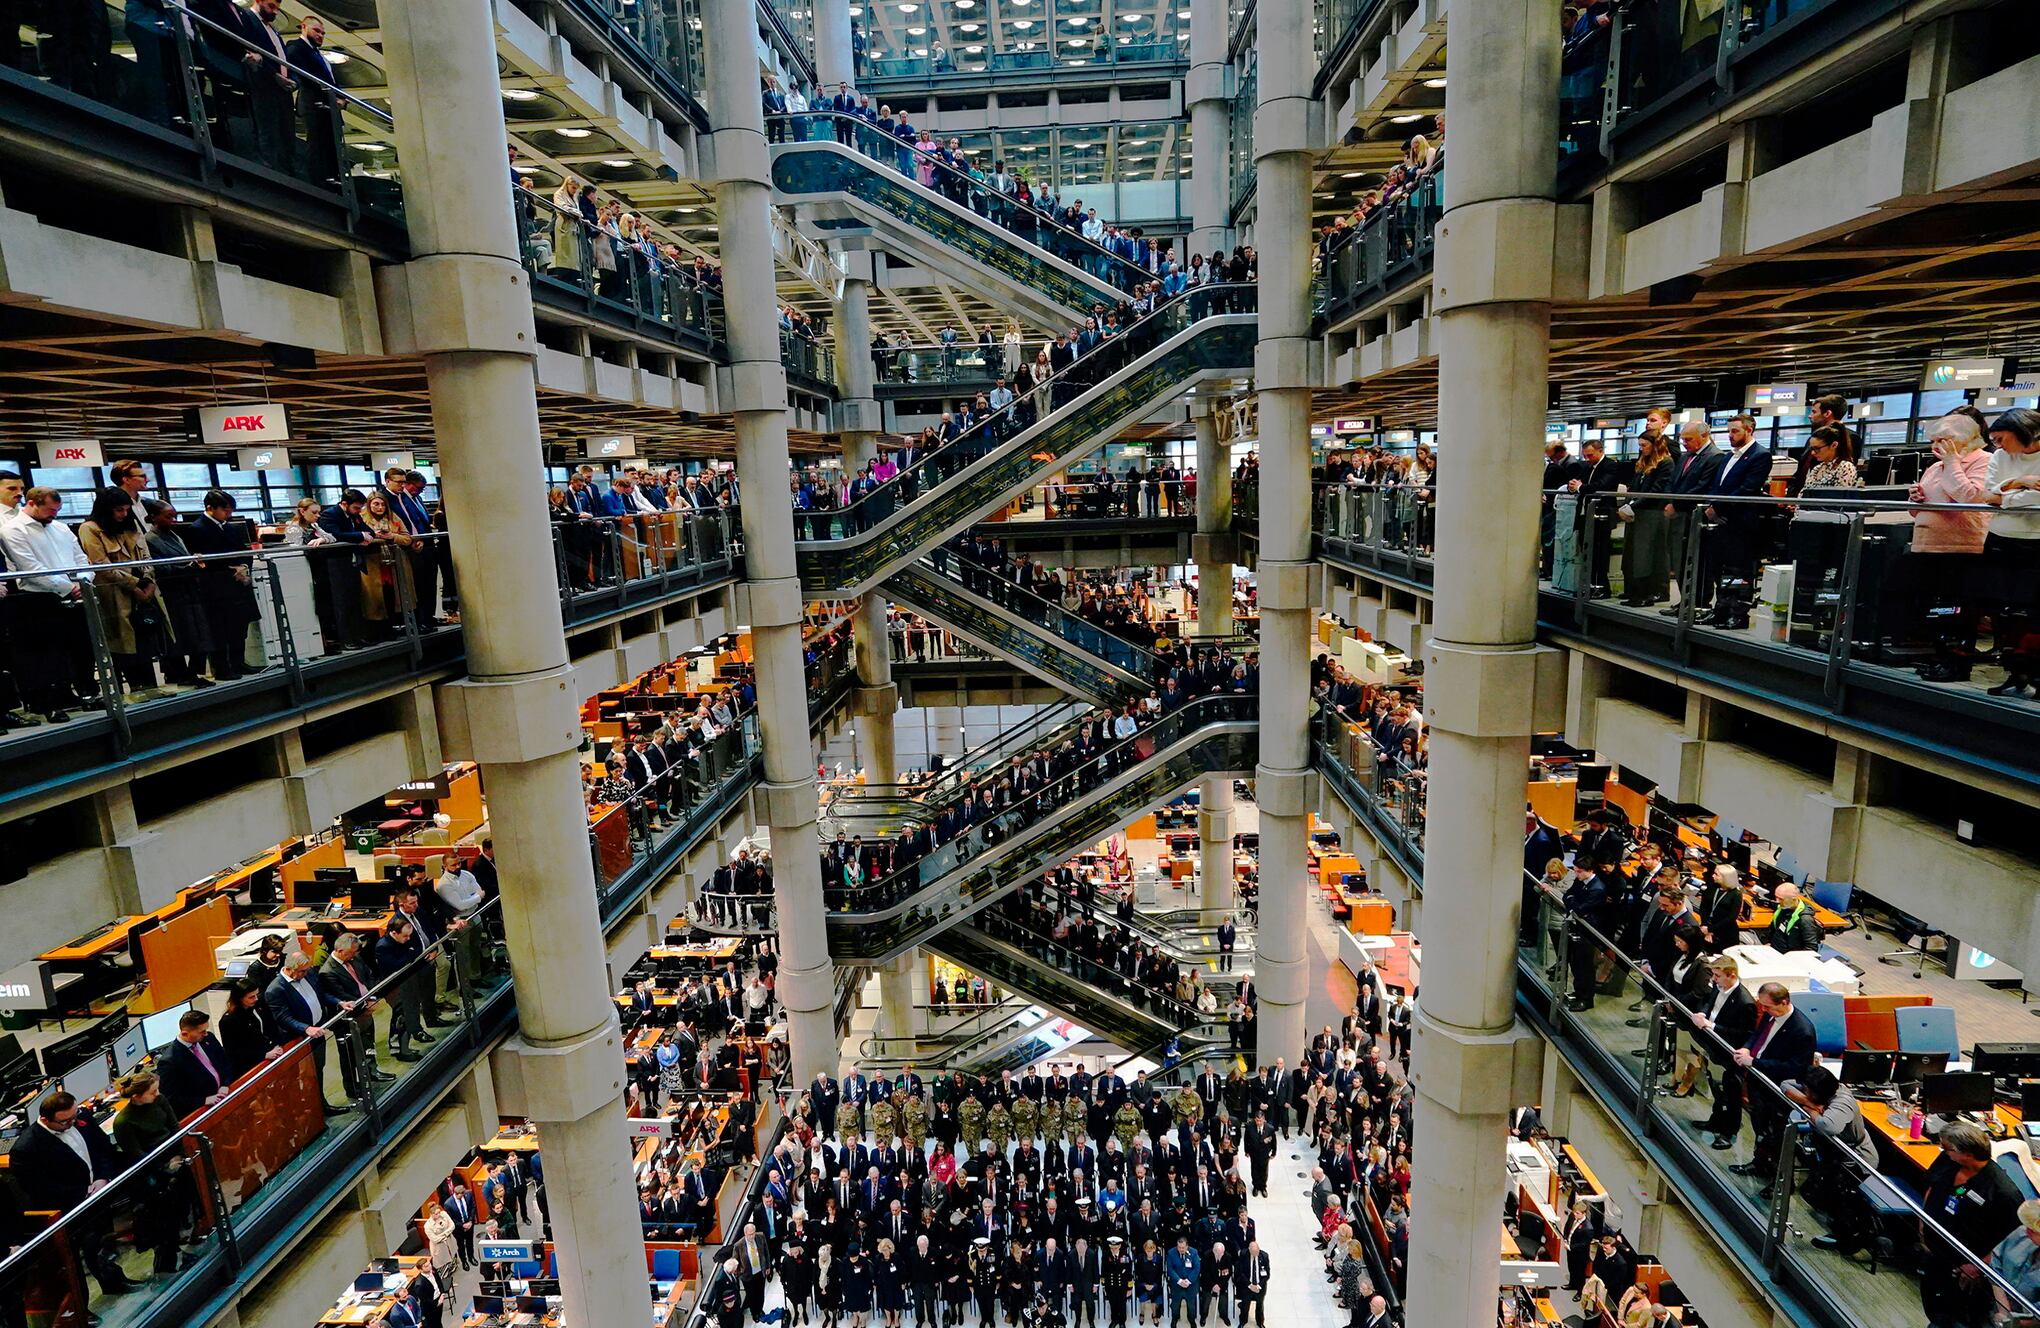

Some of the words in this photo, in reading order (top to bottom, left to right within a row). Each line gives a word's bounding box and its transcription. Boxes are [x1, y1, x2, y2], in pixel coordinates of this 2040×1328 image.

[223, 415, 266, 431] ARK
[55, 448, 86, 460] ARK
[0, 983, 31, 998] eim
[640, 1125, 660, 1133] ARK
[502, 1248, 520, 1256] Arch
